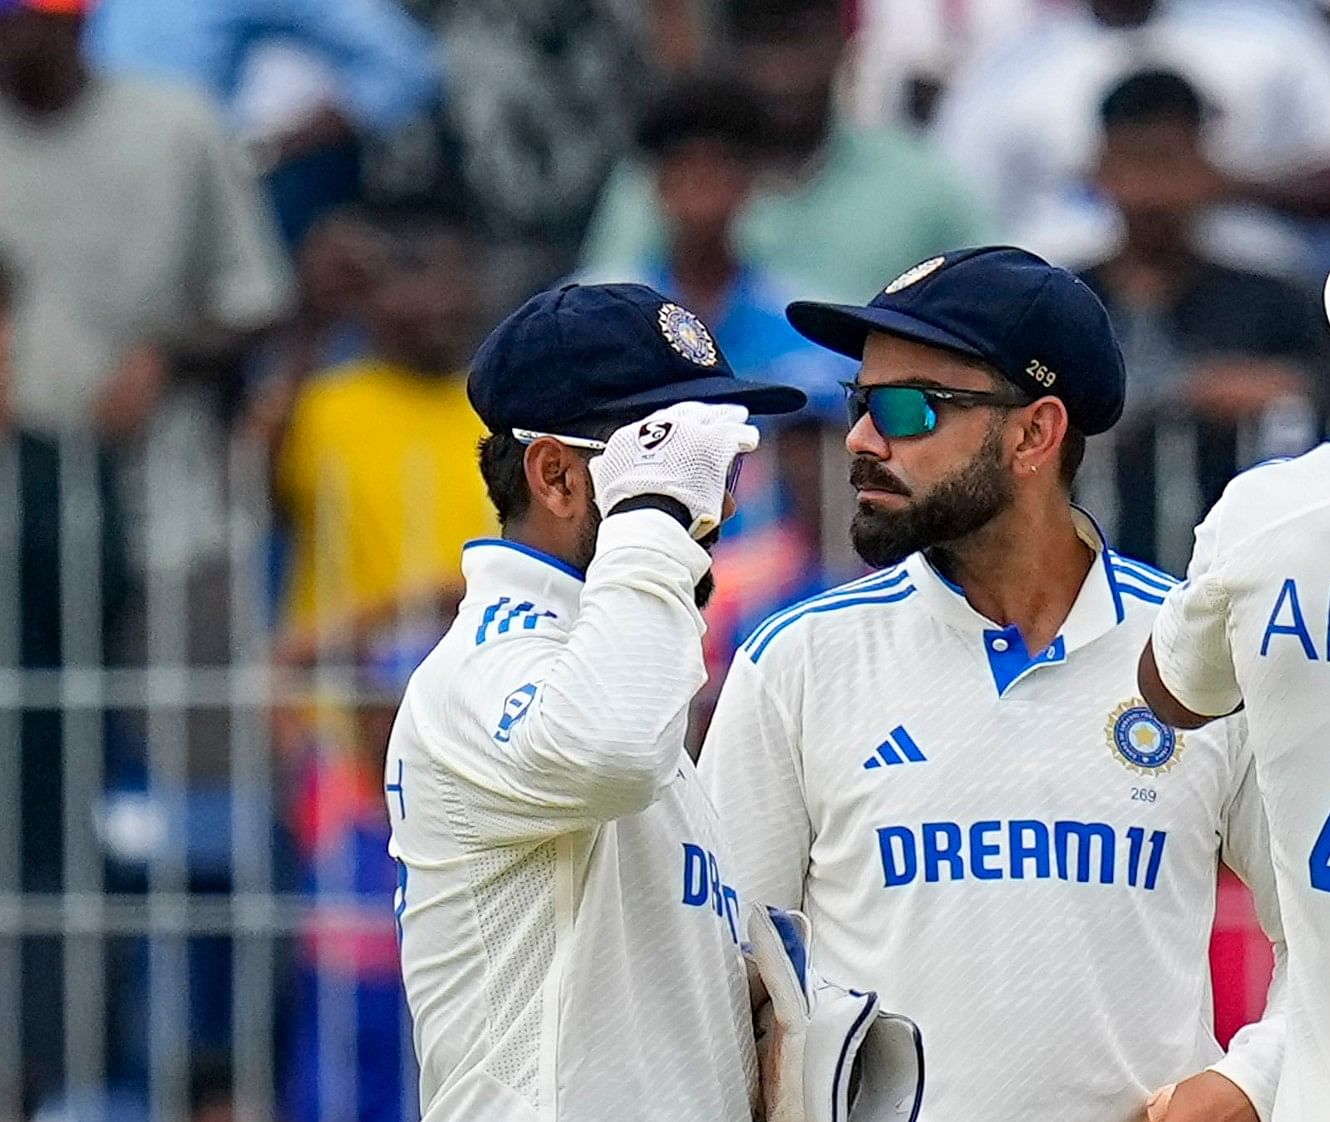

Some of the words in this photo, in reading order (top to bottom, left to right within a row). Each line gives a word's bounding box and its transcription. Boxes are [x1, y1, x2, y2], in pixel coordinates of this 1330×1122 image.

[1025, 359, 1057, 388] 269
[1130, 786, 1158, 803] 269
[875, 819, 1167, 891] DREAM11
